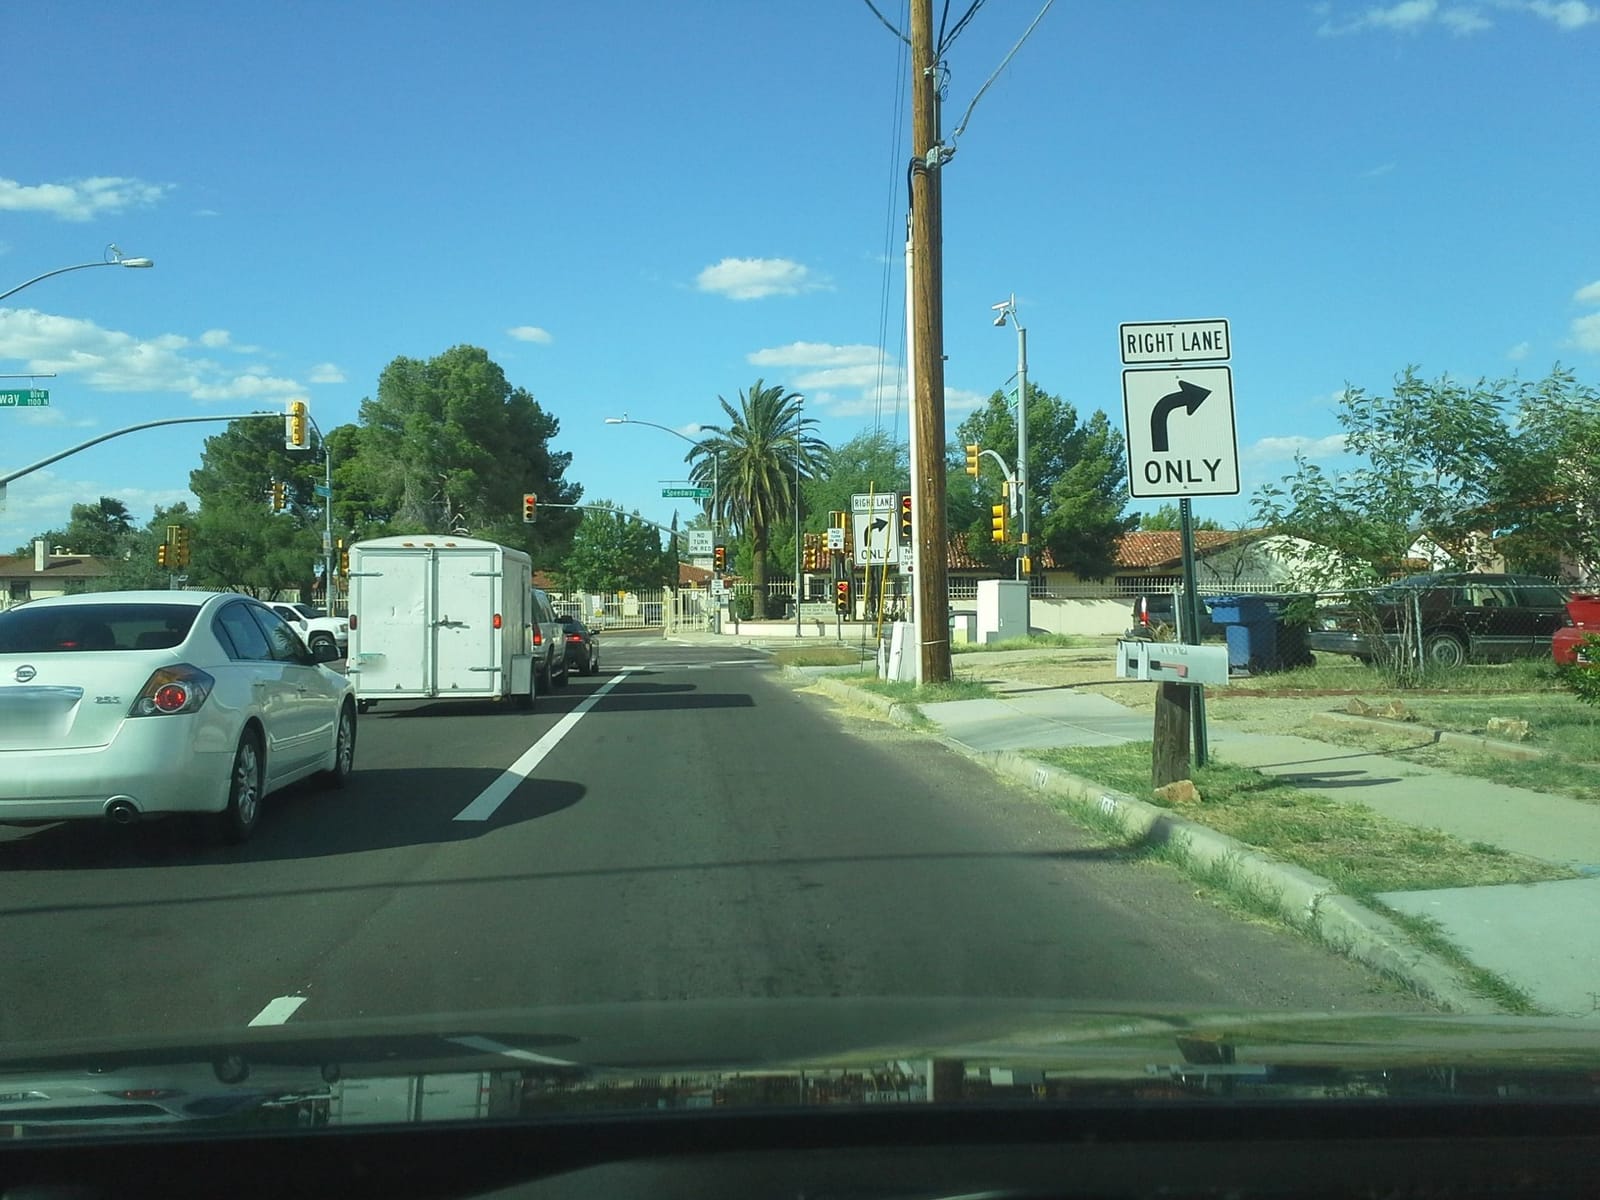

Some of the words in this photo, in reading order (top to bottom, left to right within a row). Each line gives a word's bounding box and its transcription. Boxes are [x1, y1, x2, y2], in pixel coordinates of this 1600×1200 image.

[1127, 332, 1174, 354] RIGHT
[1181, 330, 1223, 352] LANE
[1144, 458, 1222, 484] ONLY
[876, 496, 894, 507] LANE
[861, 549, 892, 560] ONLY
